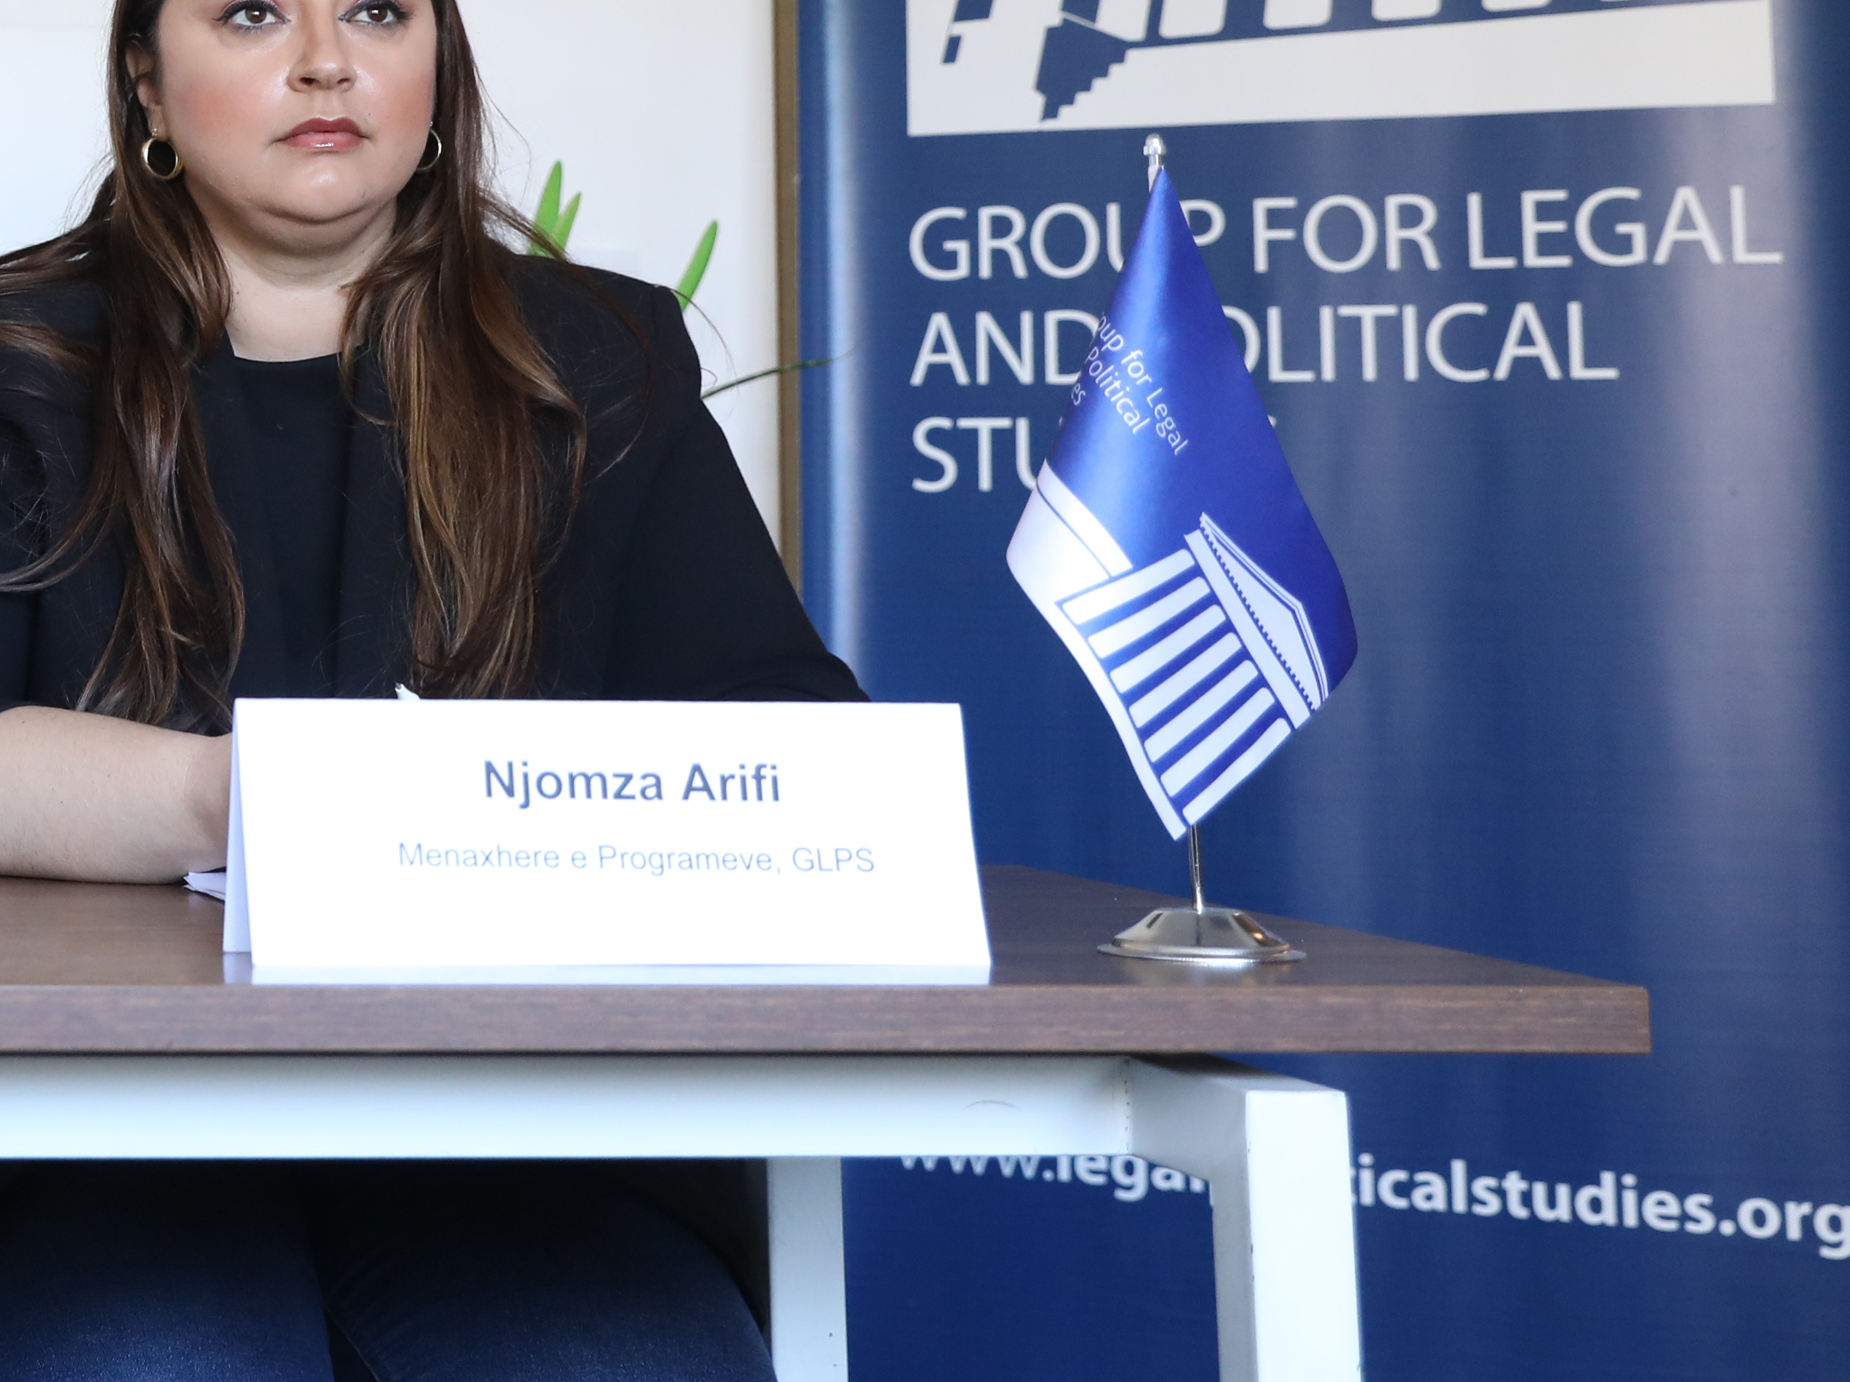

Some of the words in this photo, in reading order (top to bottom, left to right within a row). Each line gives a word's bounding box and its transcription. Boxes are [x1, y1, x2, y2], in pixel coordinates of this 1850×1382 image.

[1251, 193, 1441, 274] FOR
[1466, 184, 1784, 270] LEGAL
[909, 308, 1102, 387] AND
[1220, 299, 1621, 384] LITICAL
[1083, 345, 1151, 435] Political
[1121, 348, 1152, 385] for
[1146, 386, 1189, 456] Legal
[484, 759, 664, 810] Njomza
[681, 763, 780, 803] Arifi
[398, 841, 560, 869] Menaxhere
[570, 850, 588, 869] e
[597, 844, 782, 877] Programeve,
[791, 846, 875, 873] GLPS
